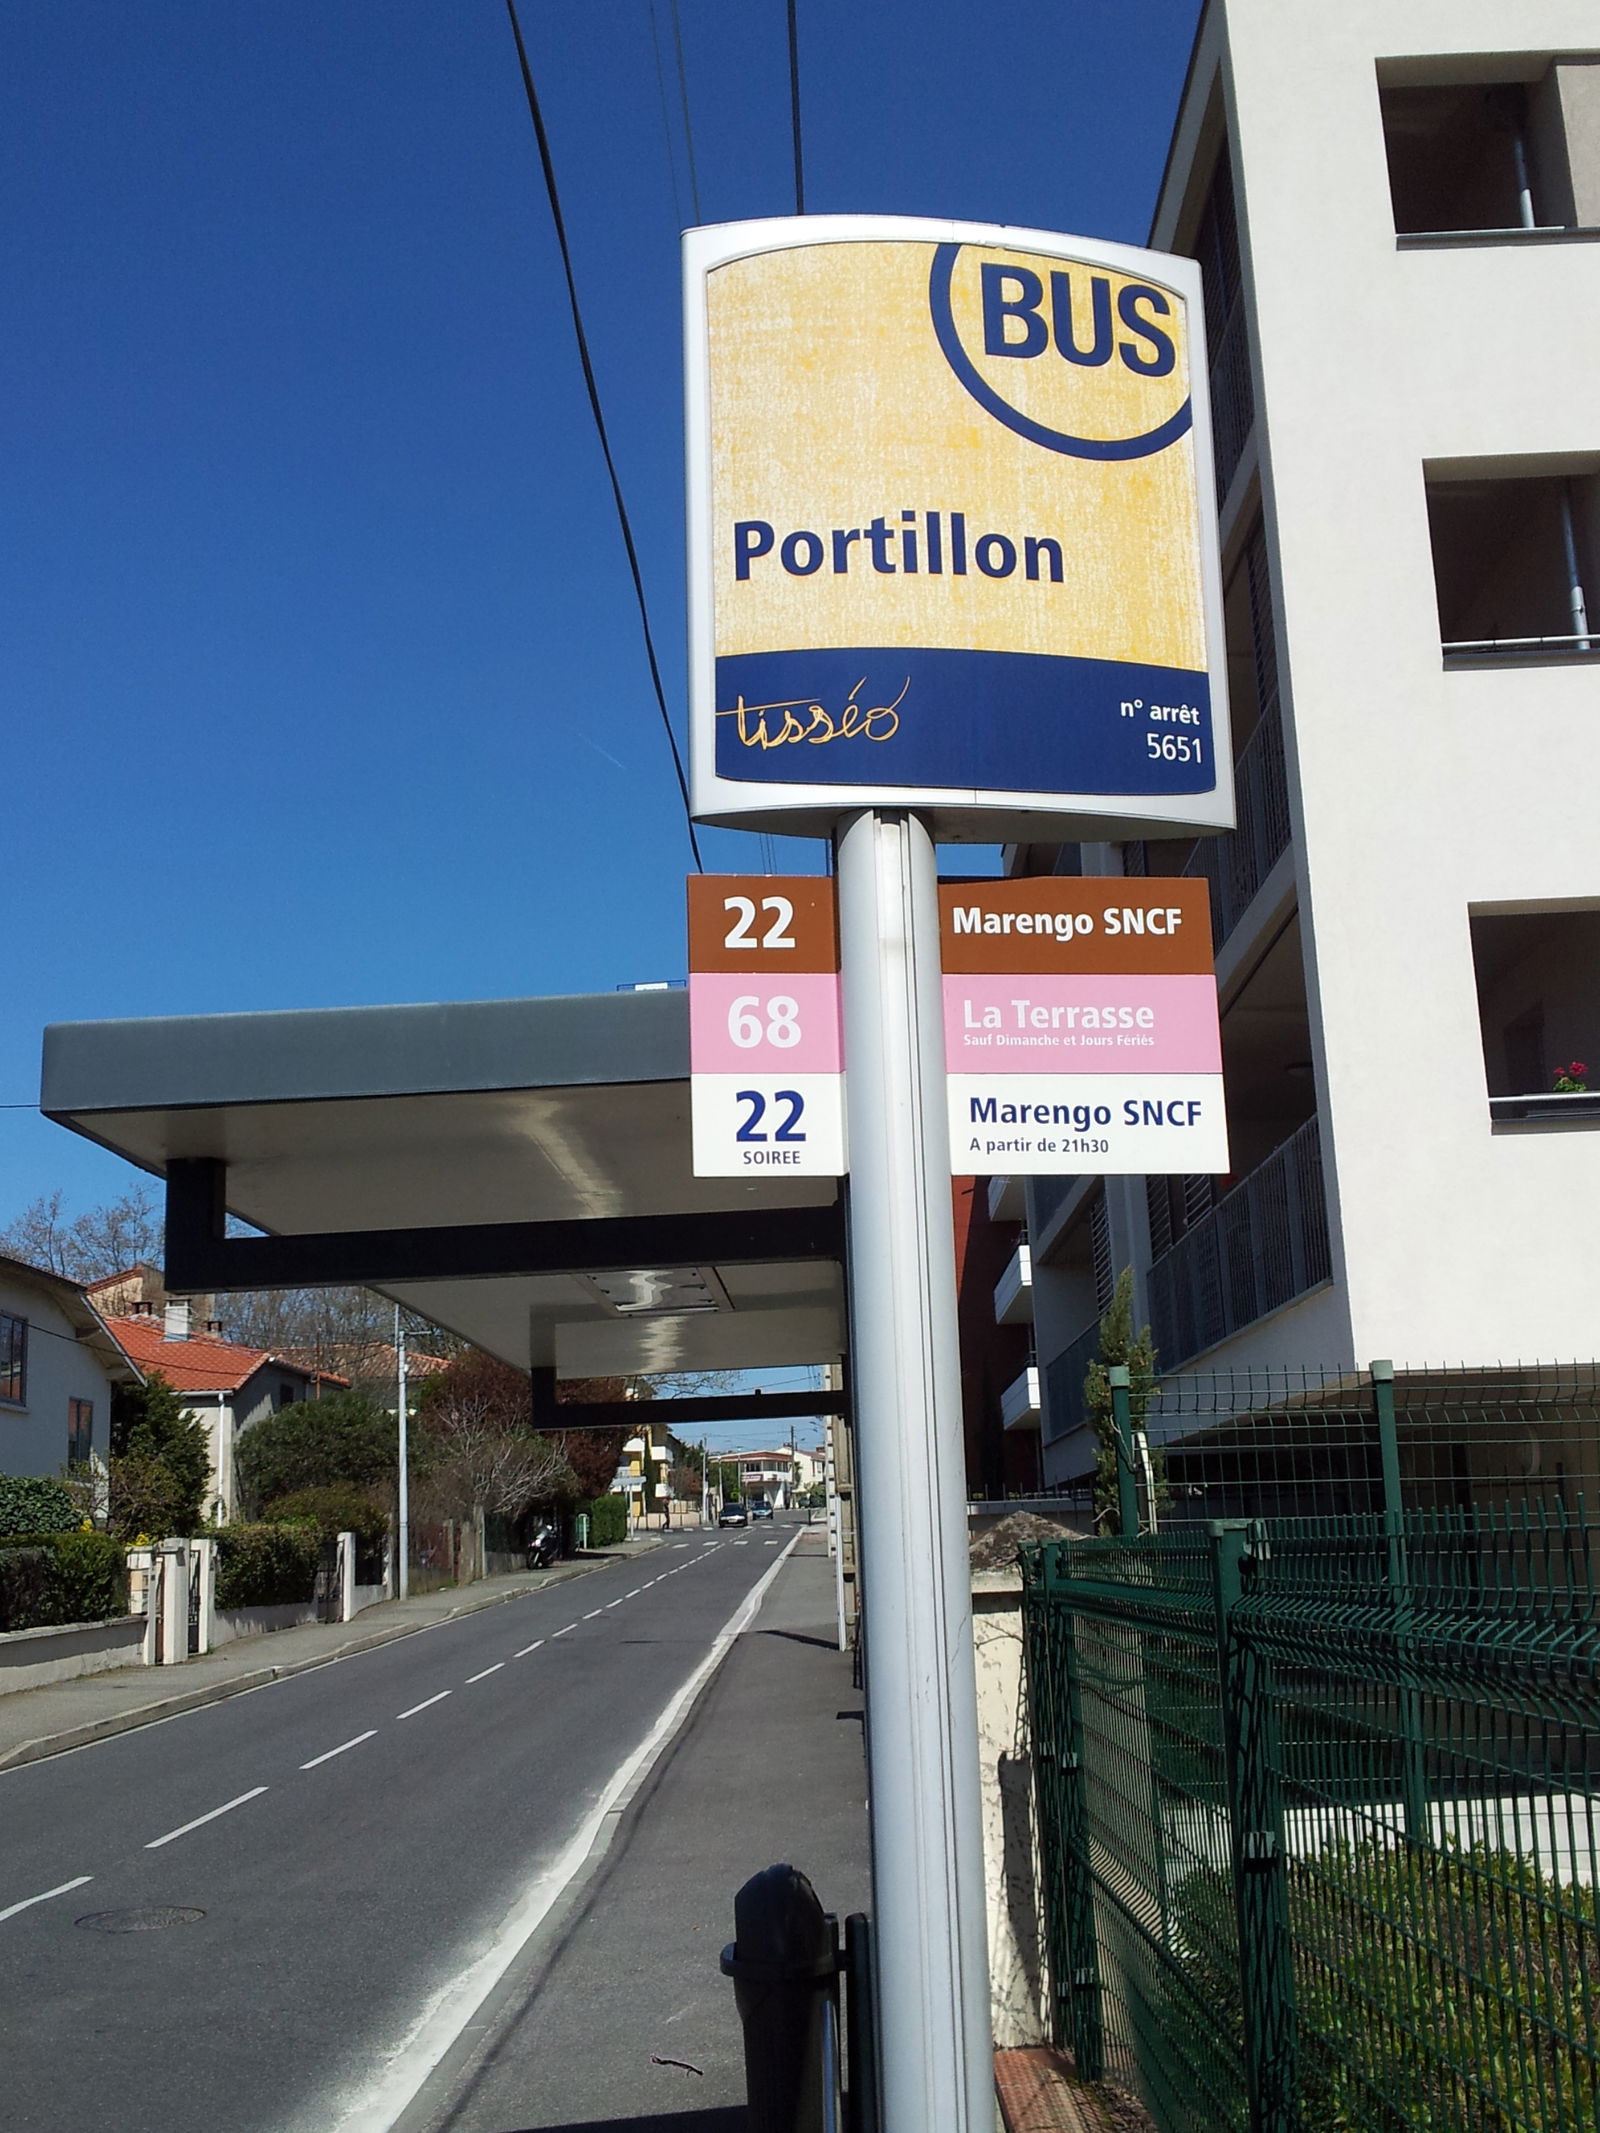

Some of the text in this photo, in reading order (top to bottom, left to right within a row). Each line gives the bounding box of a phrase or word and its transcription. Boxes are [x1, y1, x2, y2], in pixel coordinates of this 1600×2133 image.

[980, 262, 1177, 378] BUS
[734, 510, 1064, 583] Portillon
[716, 676, 911, 750] tisséo
[1120, 699, 1200, 725] n° arrêt
[1147, 732, 1202, 763] 5651
[724, 896, 796, 949] 22
[952, 907, 1182, 942] Marengo SNCF
[727, 995, 802, 1049] 68
[963, 999, 1155, 1029] La Terrasse
[963, 1034, 1155, 1046] Sauf Dimanche et Jours Fériés
[735, 1090, 806, 1142] 22
[970, 1097, 1202, 1133] Marengo SNCF
[743, 1150, 801, 1165] SOIREE
[969, 1137, 1109, 1155] A partir de 21h30
